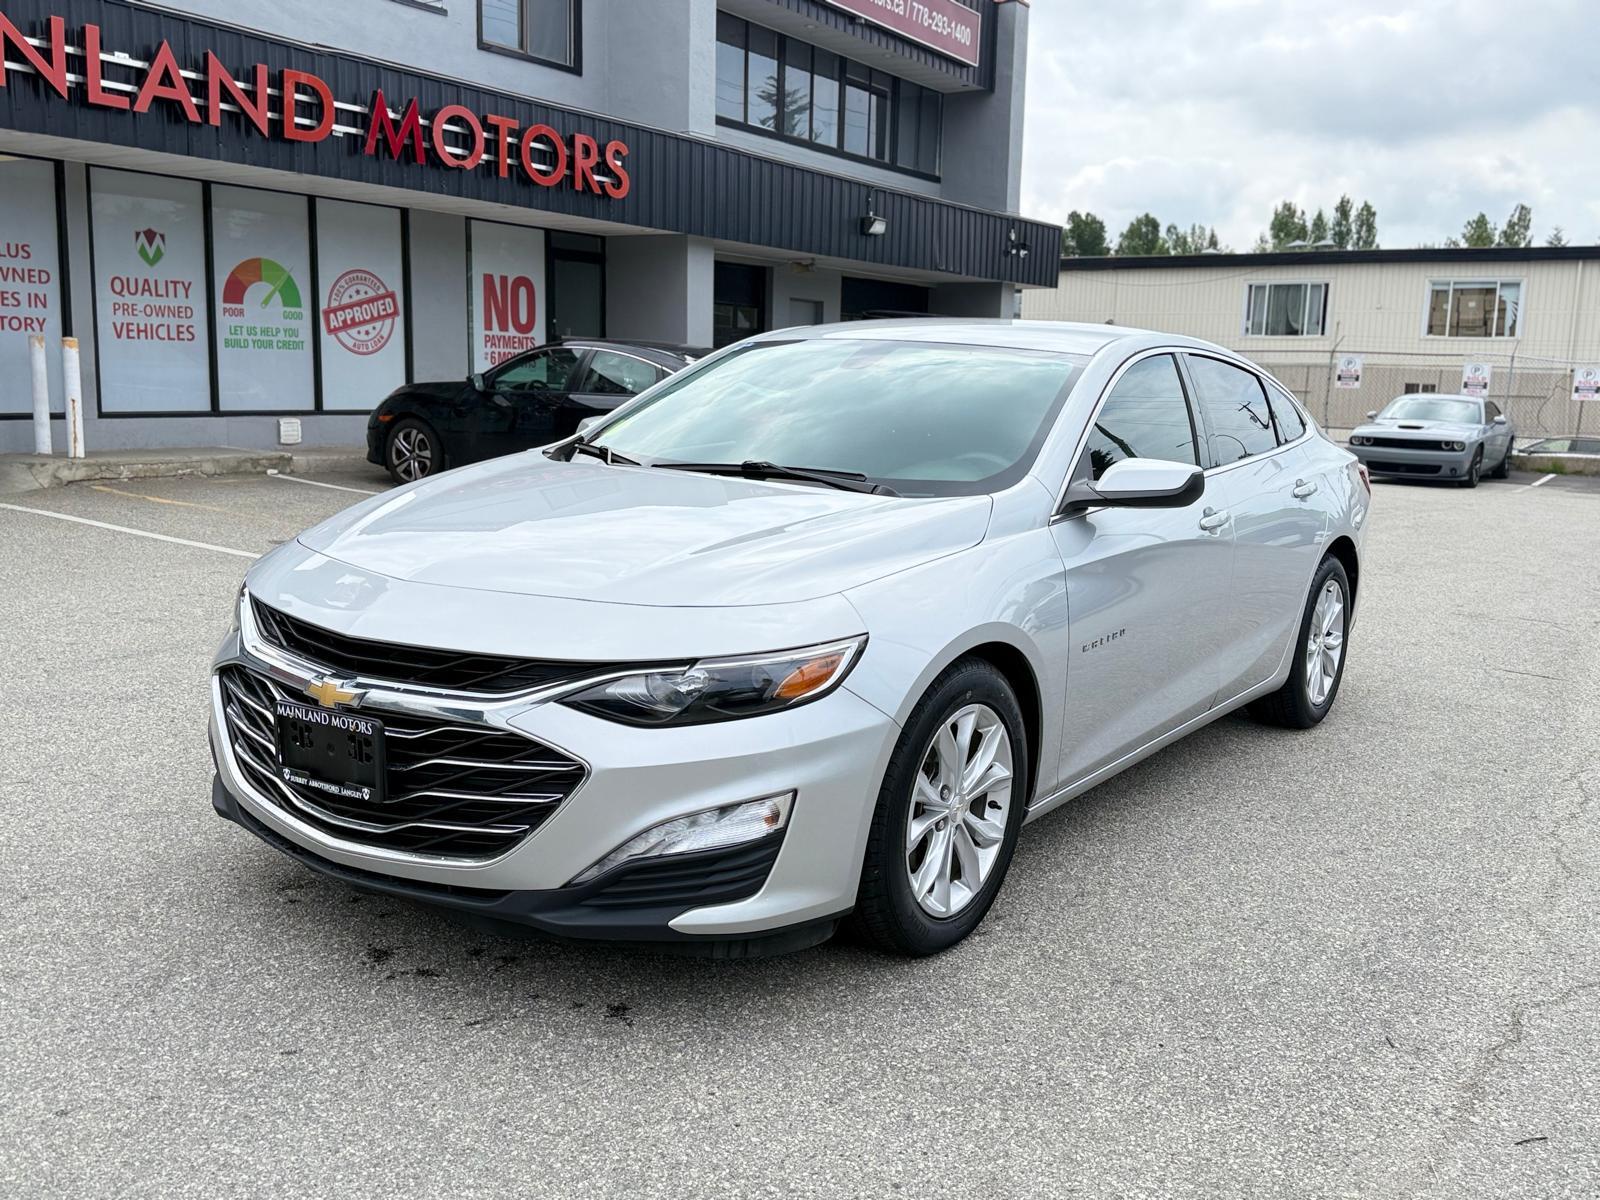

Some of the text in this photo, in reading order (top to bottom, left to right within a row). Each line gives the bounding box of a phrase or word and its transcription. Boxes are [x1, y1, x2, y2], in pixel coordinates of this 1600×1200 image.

[912, 2, 971, 46] 778-293-1400
[0, 11, 630, 199] NLAND MOTORS
[110, 276, 192, 299] QUALITY
[28, 292, 47, 309] IN
[483, 273, 536, 334] NO
[113, 302, 194, 319] PRE-OWNED
[223, 307, 245, 318] POOR
[282, 310, 303, 321] GOOD
[329, 297, 395, 329] APPROVED
[112, 321, 196, 342] VEHICLES
[229, 325, 299, 338] LET US HELP YOU
[224, 338, 304, 351] BUILD YOUR CREDIT
[484, 334, 536, 351] PAYMENTS
[490, 351, 497, 365] 6
[277, 703, 373, 735] MAINLAND MOTORS
[340, 787, 363, 800] LANGLEY
